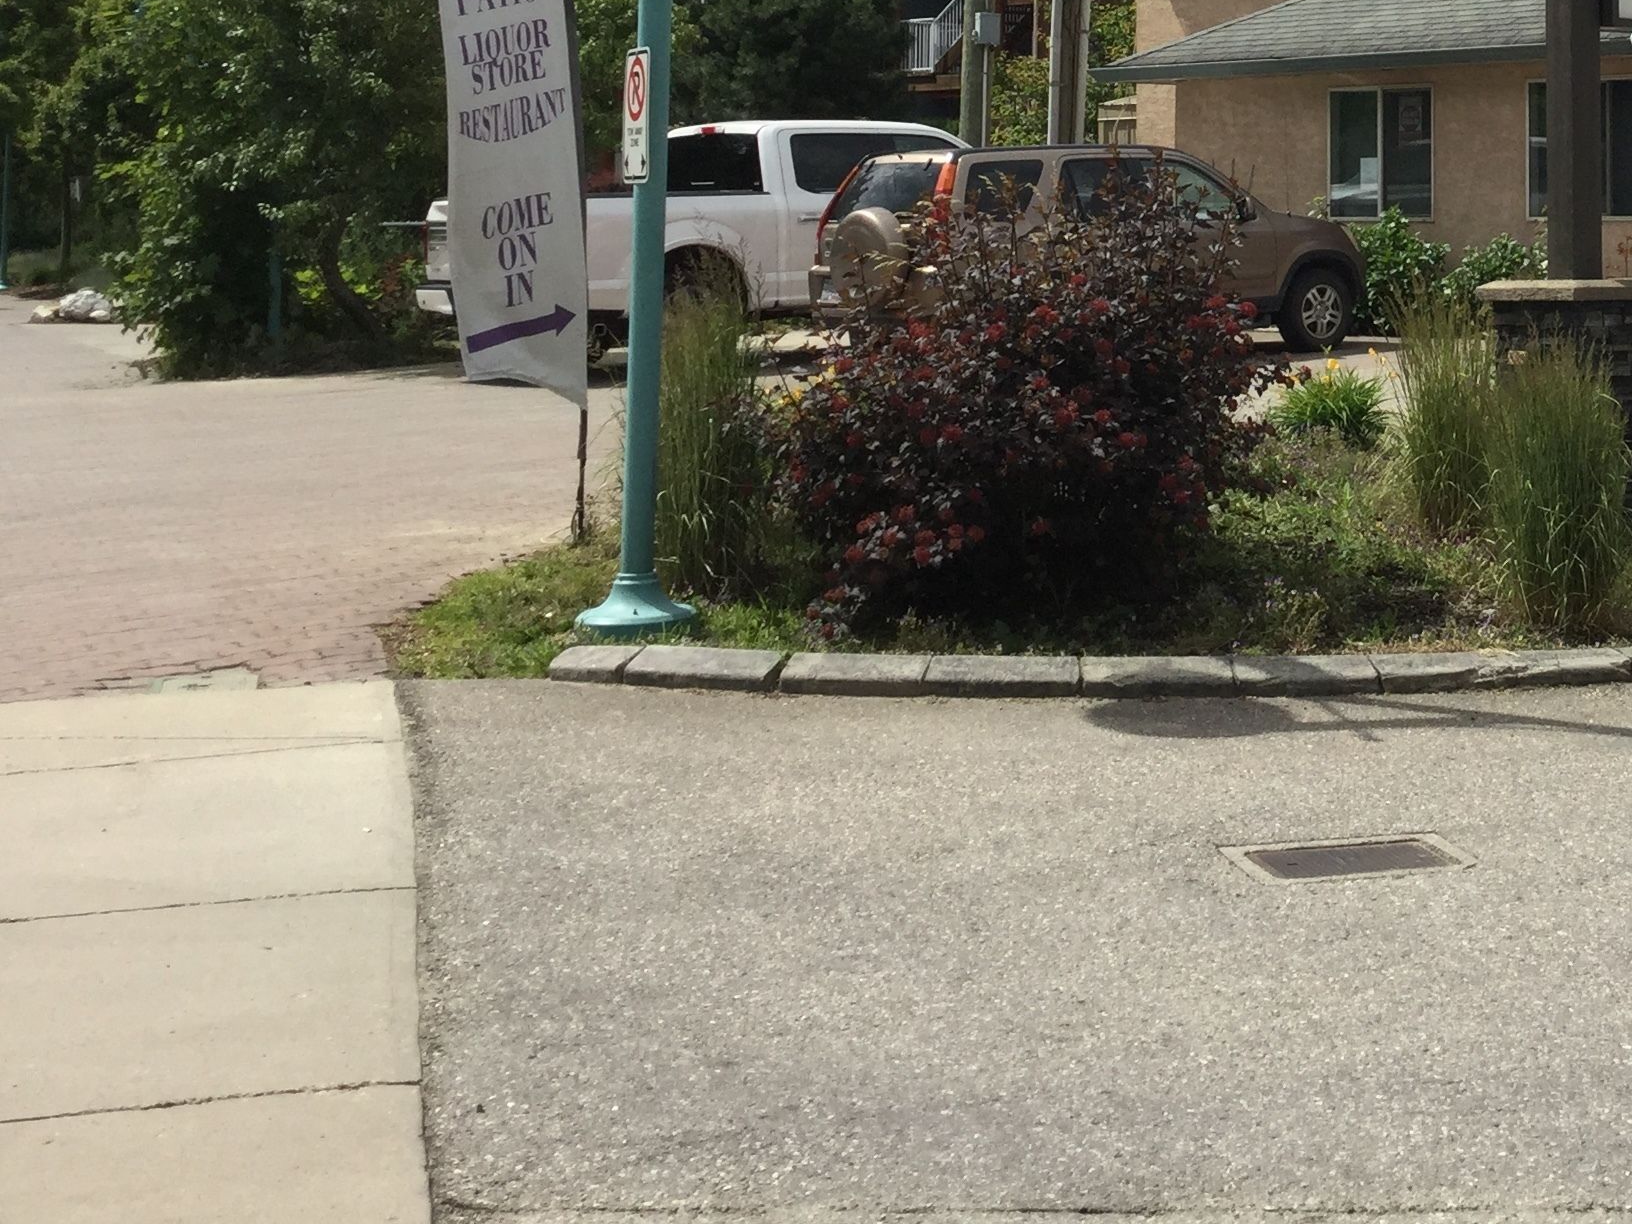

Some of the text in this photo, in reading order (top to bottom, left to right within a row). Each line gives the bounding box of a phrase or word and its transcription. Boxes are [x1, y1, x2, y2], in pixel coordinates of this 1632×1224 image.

[458, 18, 551, 67] LIQUOR
[471, 49, 546, 95] STORE
[459, 87, 566, 143] RESTAURANT
[481, 191, 553, 239] COME
[498, 232, 538, 270] ON
[504, 270, 534, 308] IN
